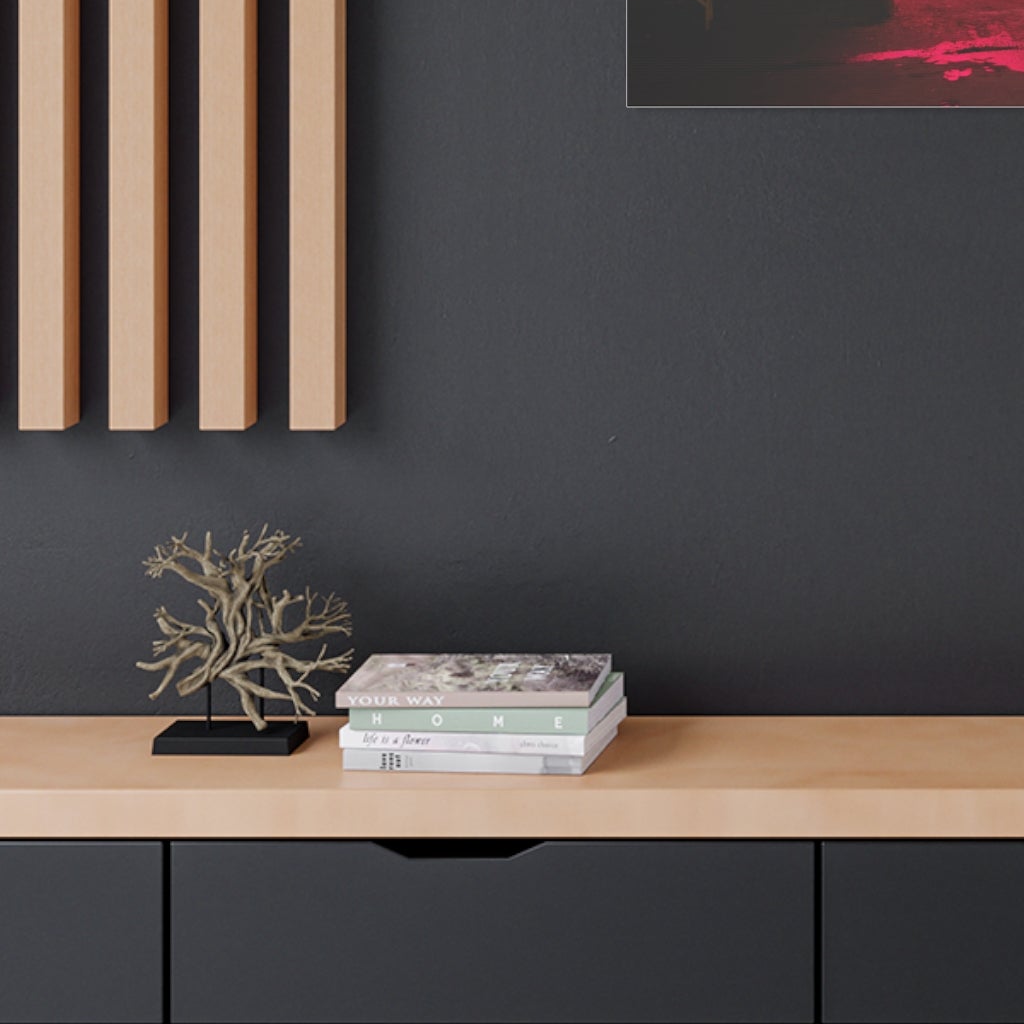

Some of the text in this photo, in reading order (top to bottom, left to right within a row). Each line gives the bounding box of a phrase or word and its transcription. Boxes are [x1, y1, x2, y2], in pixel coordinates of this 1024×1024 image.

[348, 696, 445, 706] YOUR WAY
[371, 713, 563, 729] HOME
